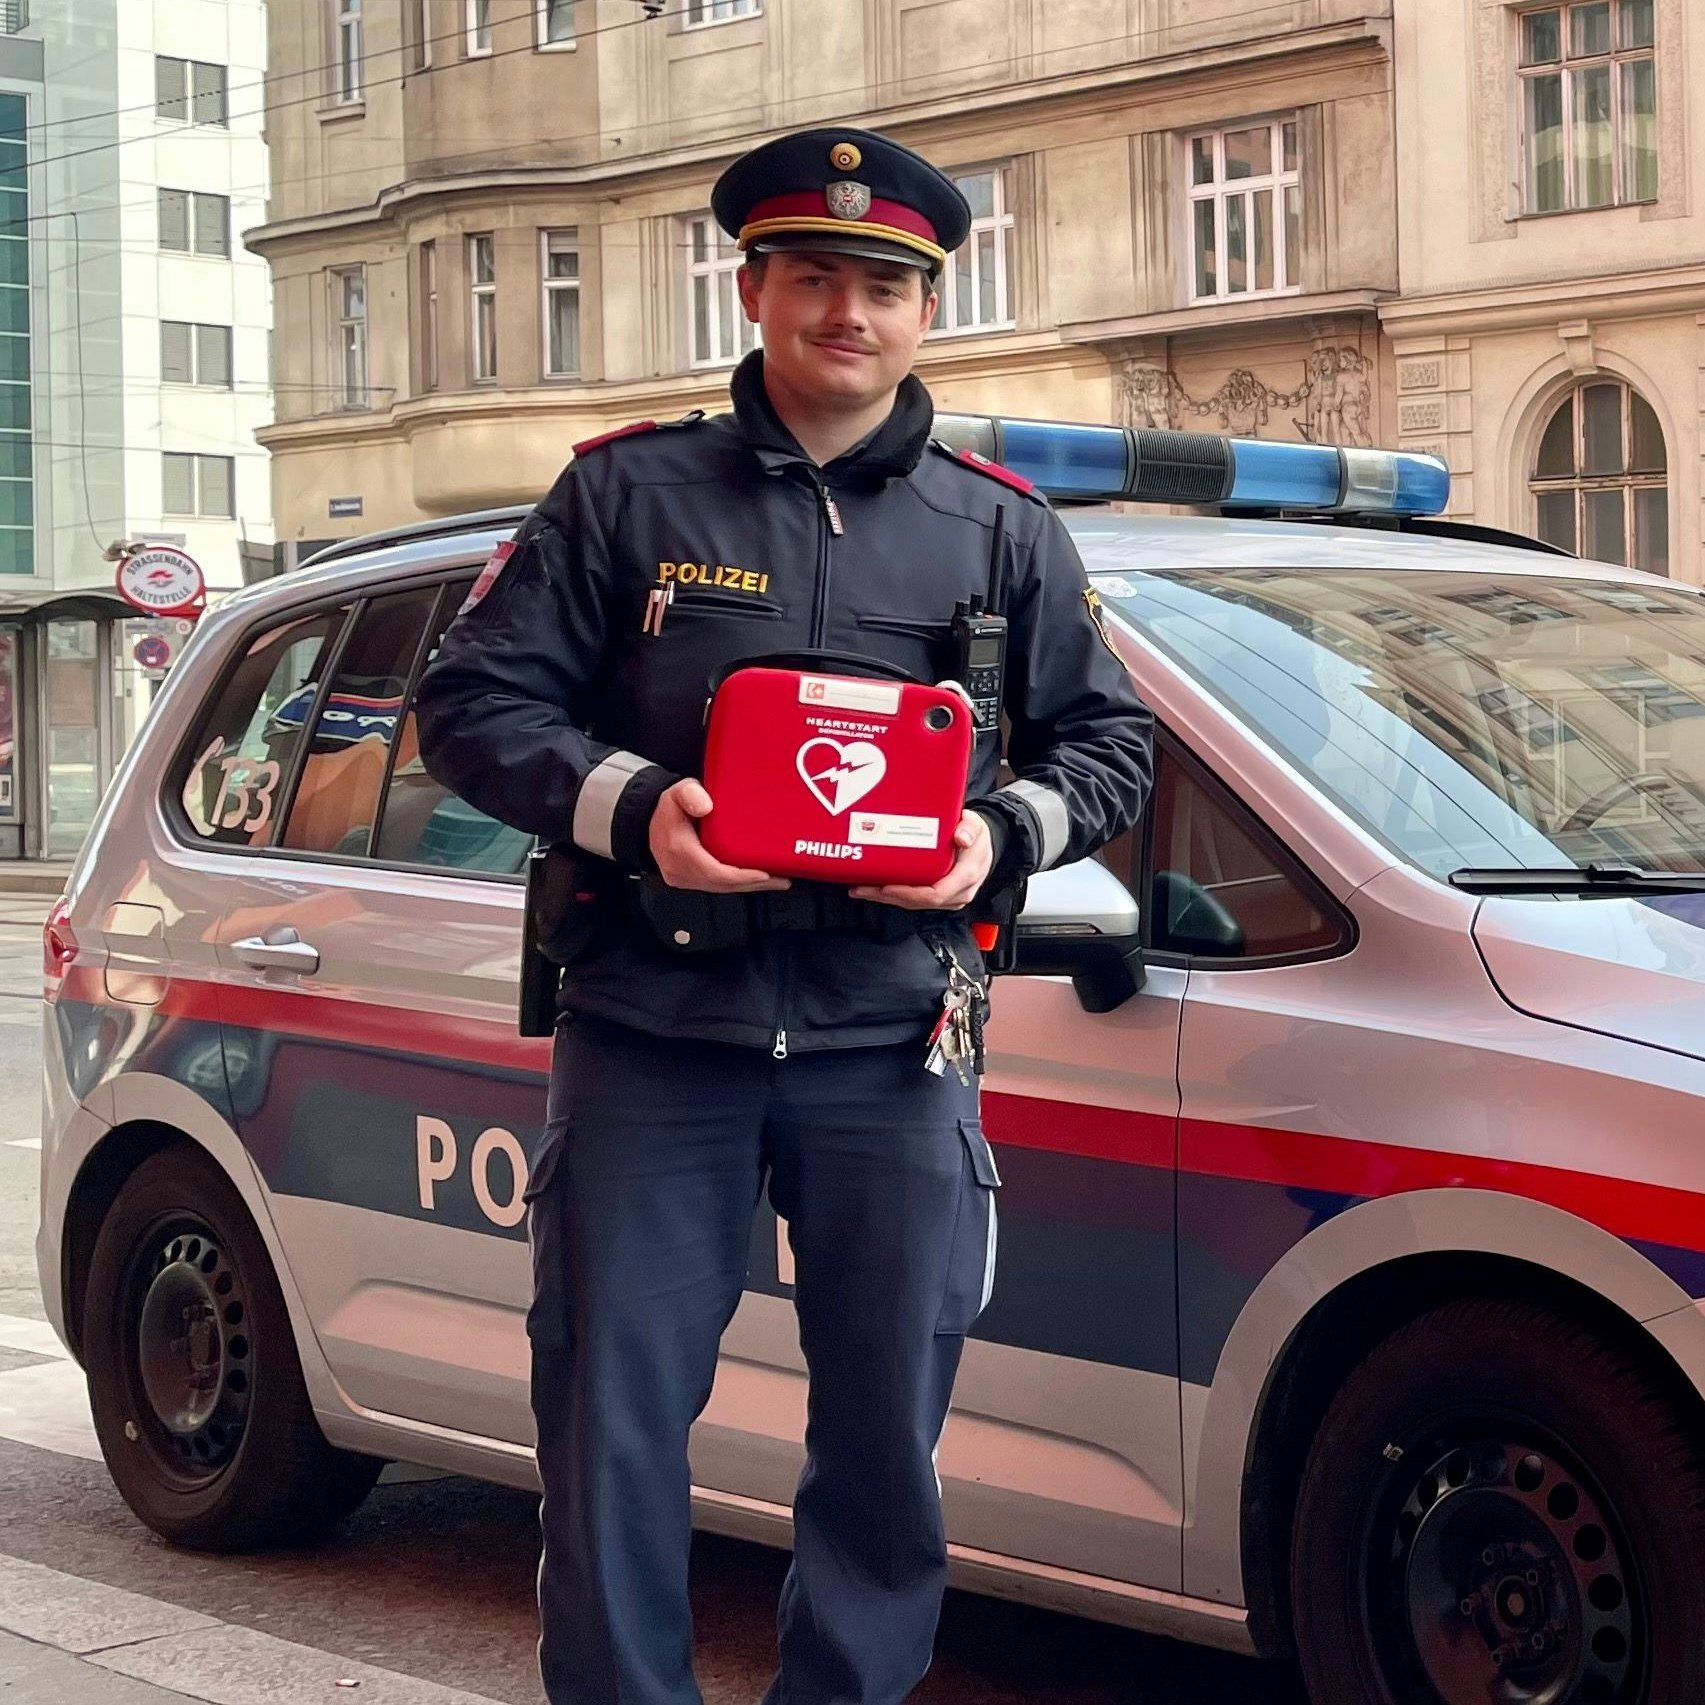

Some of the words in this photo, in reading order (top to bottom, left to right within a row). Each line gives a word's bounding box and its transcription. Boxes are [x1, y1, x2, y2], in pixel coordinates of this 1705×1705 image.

[126, 553, 194, 576] STRASSENBAHN
[656, 562, 769, 593] POLIZEI
[131, 585, 192, 604] HALTESTELLE
[806, 717, 889, 734] HEARTSTART
[211, 756, 280, 832] 133
[794, 839, 863, 860] PHILIPS
